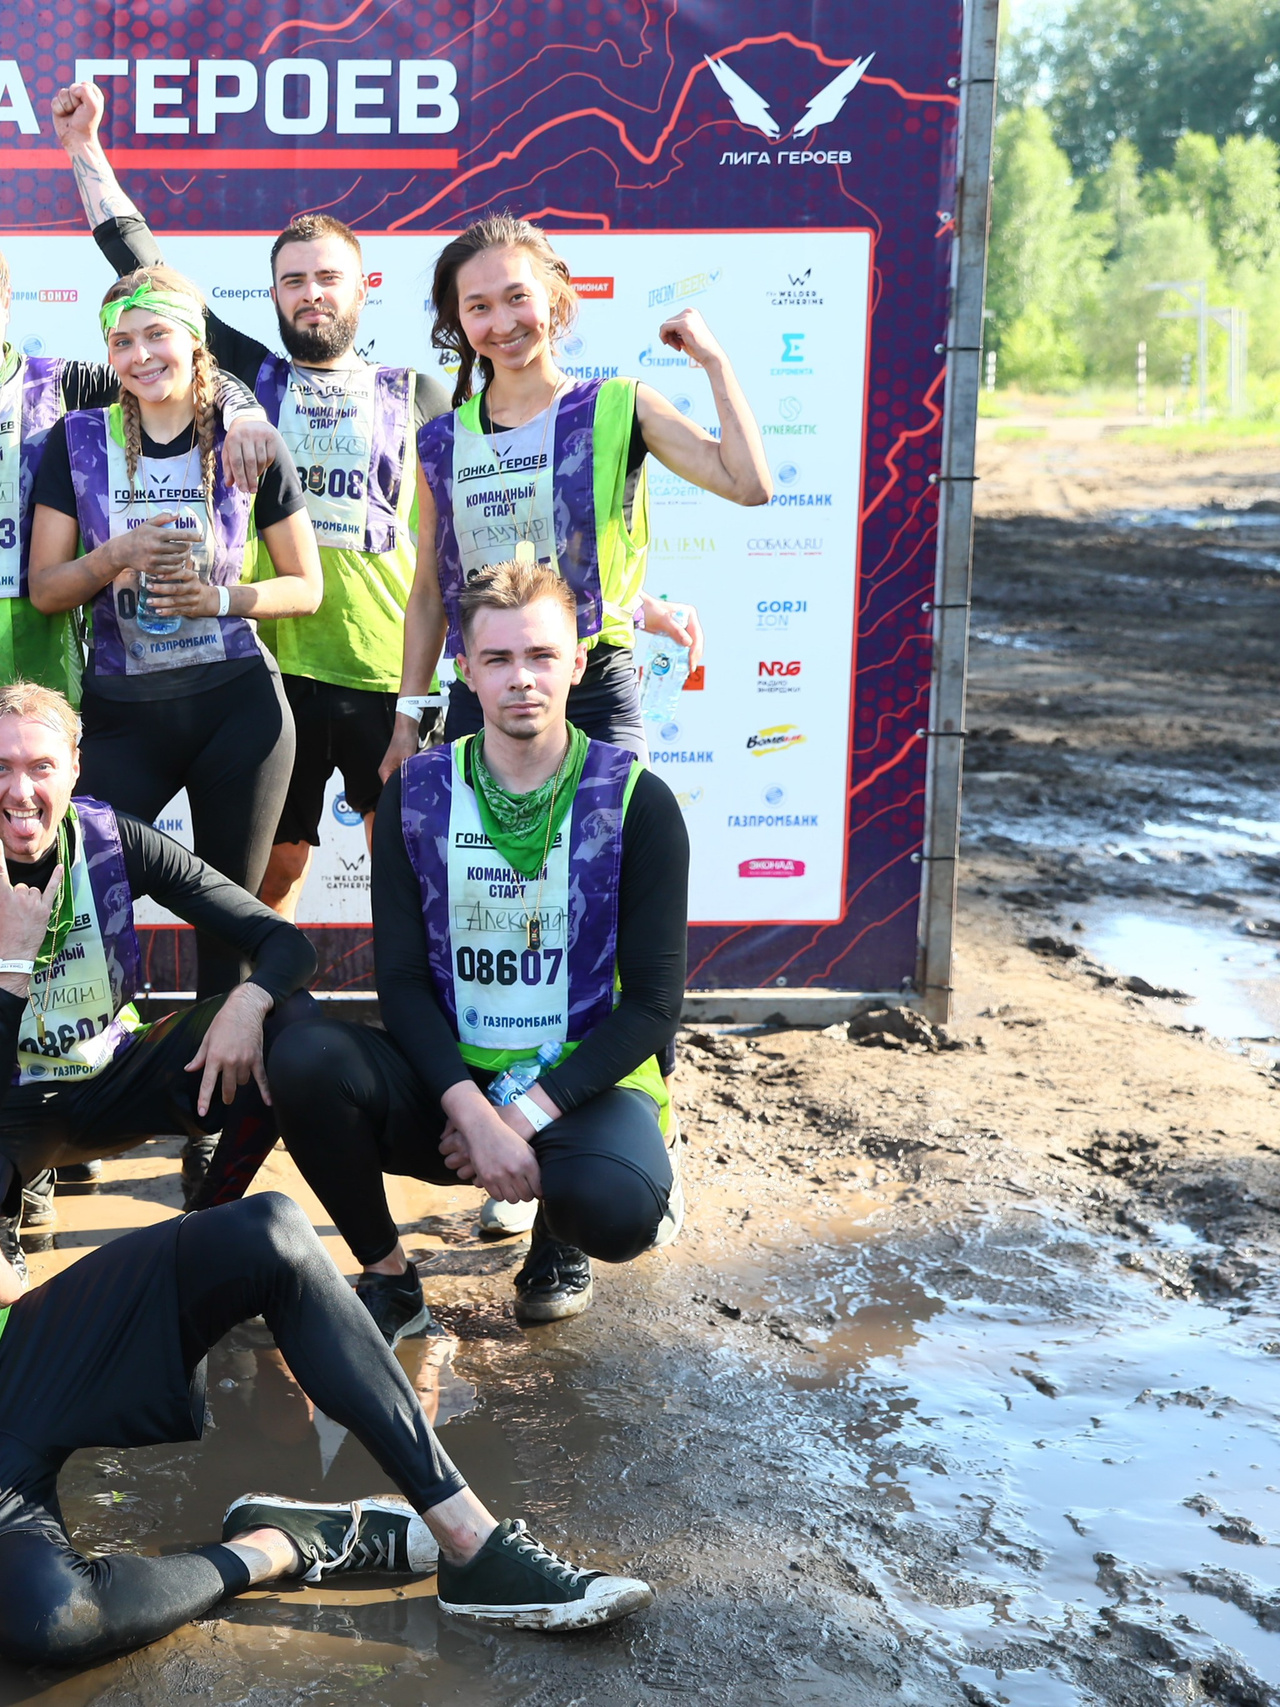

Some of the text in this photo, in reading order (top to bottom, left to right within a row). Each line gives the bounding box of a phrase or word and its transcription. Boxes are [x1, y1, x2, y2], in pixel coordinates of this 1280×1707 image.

[75, 58, 460, 135] ГЕРОЕВ
[719, 151, 852, 165] ЛИГА ГЕРОЕВ
[212, 287, 270, 299] Северста
[572, 283, 609, 291] ПИОНАТ
[11, 291, 77, 300] ЗПРОМ БОНУС
[562, 367, 618, 378] ОМБАНК
[295, 404, 358, 419] КОМАНДНЫЙ
[309, 418, 339, 429] СТАРТ
[762, 425, 816, 435] SYNERGETIC
[458, 454, 548, 479] ГОНКА ГЕРОЕВ
[296, 466, 364, 499] 808
[115, 488, 205, 500] ГОНКА ГЕРОЕВ
[466, 482, 536, 508] КОМАНДНЫЙ
[768, 494, 832, 506] РОМБАНК
[483, 503, 516, 518] СТАРТ
[127, 514, 197, 529] КОМНЫЙ
[311, 520, 360, 534] ПРОМБАНК
[757, 601, 807, 612] GORJI
[756, 614, 788, 626] ION
[150, 634, 218, 653] ГАЗПРОМБАНК
[758, 661, 801, 676] NRG
[649, 752, 713, 763] РОМБАНК
[728, 815, 818, 827] ГАЗПРОМБАНК
[455, 833, 493, 844] ГОНК
[489, 885, 526, 899] СТАРТ
[456, 946, 563, 986] 08607
[34, 964, 66, 985] СТАРТ
[483, 1014, 562, 1028] ГАЗПРОМБАНК
